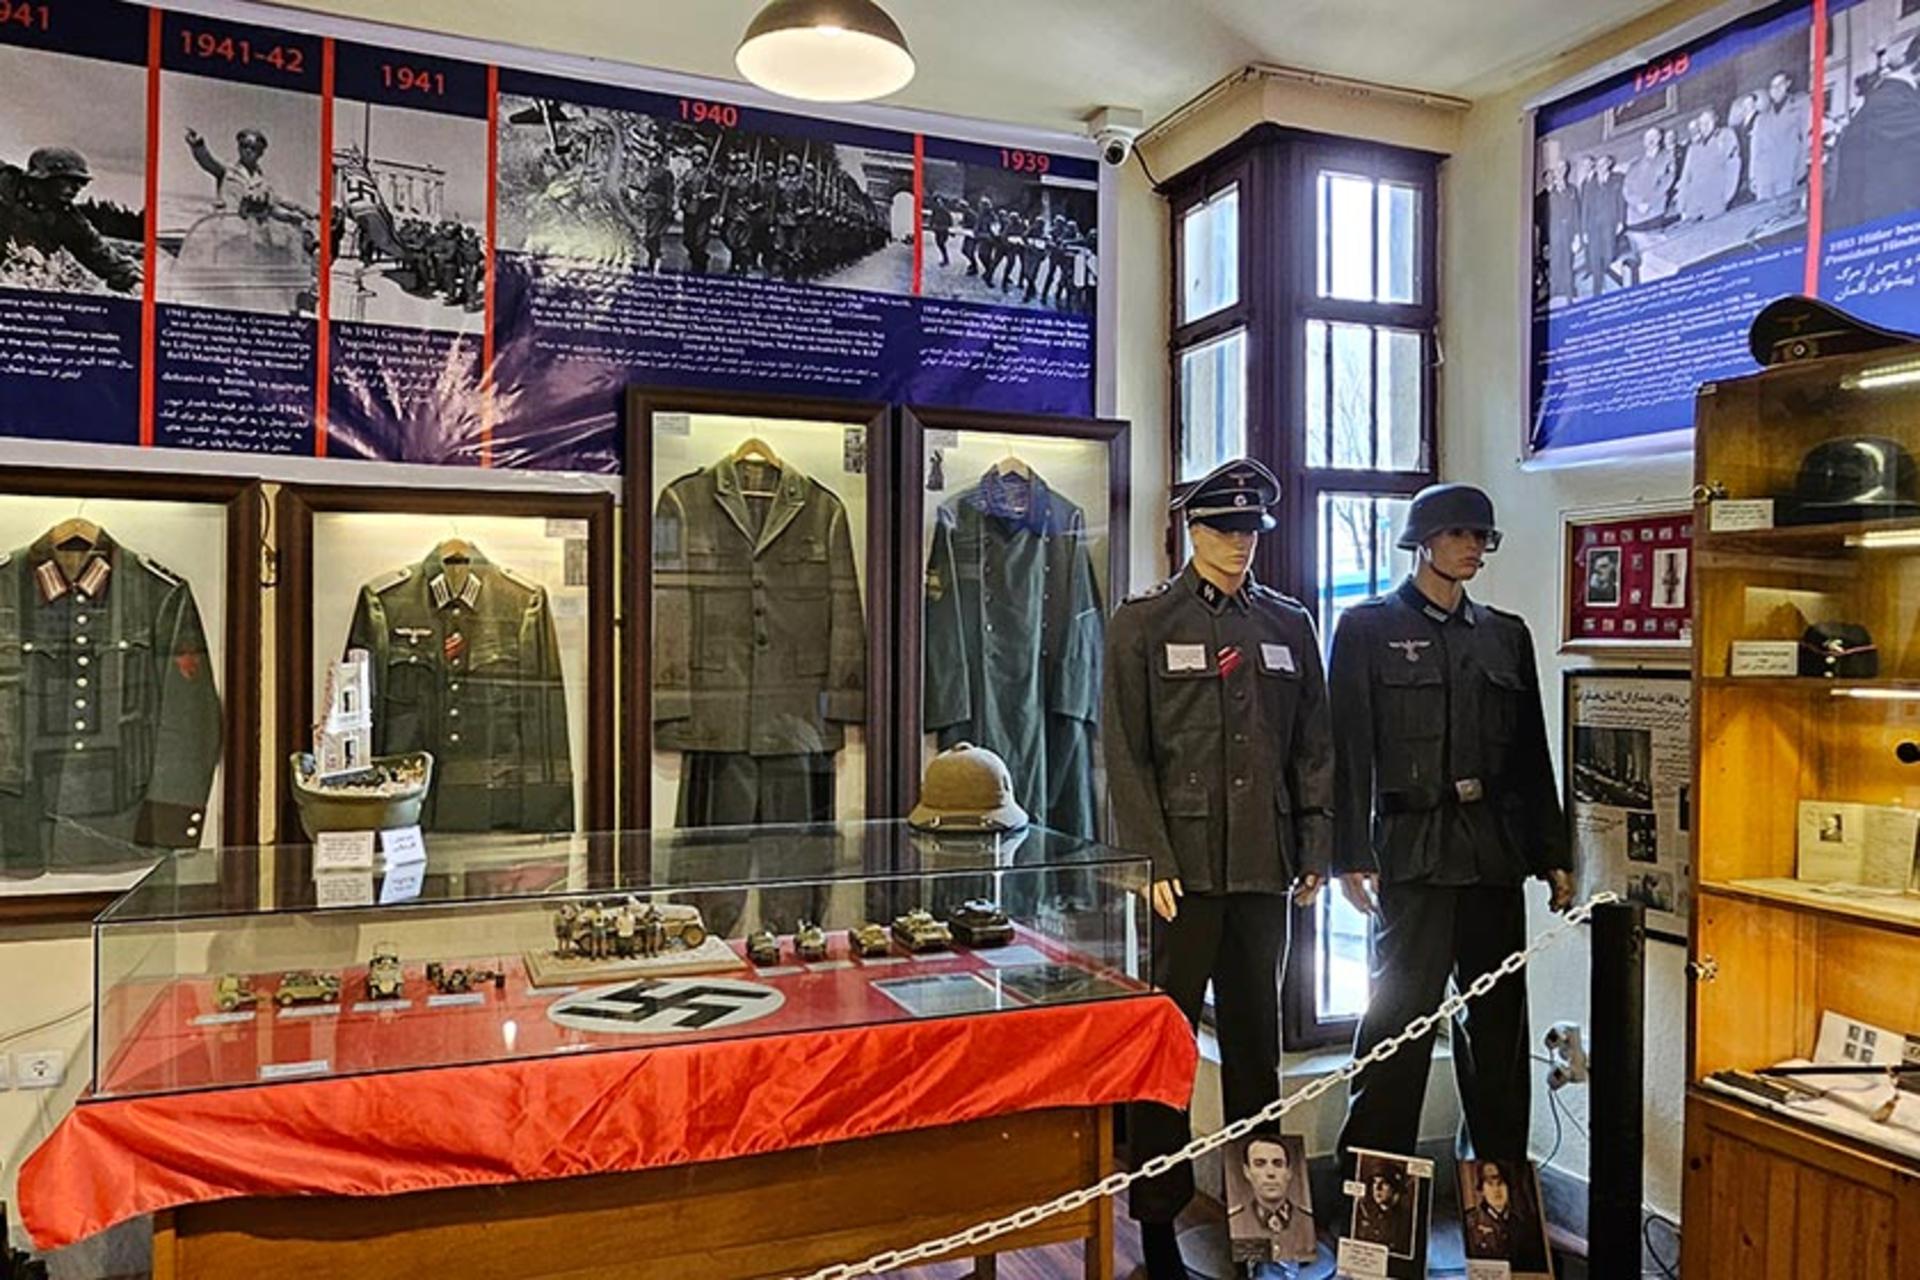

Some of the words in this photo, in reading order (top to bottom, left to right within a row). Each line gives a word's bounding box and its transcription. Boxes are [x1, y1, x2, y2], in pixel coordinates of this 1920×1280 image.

[179, 29, 304, 73] 1941-42
[382, 64, 445, 96] 1941
[680, 100, 737, 127] 1940
[1001, 149, 1050, 172] 1939
[1833, 279, 1867, 302] آلمان
